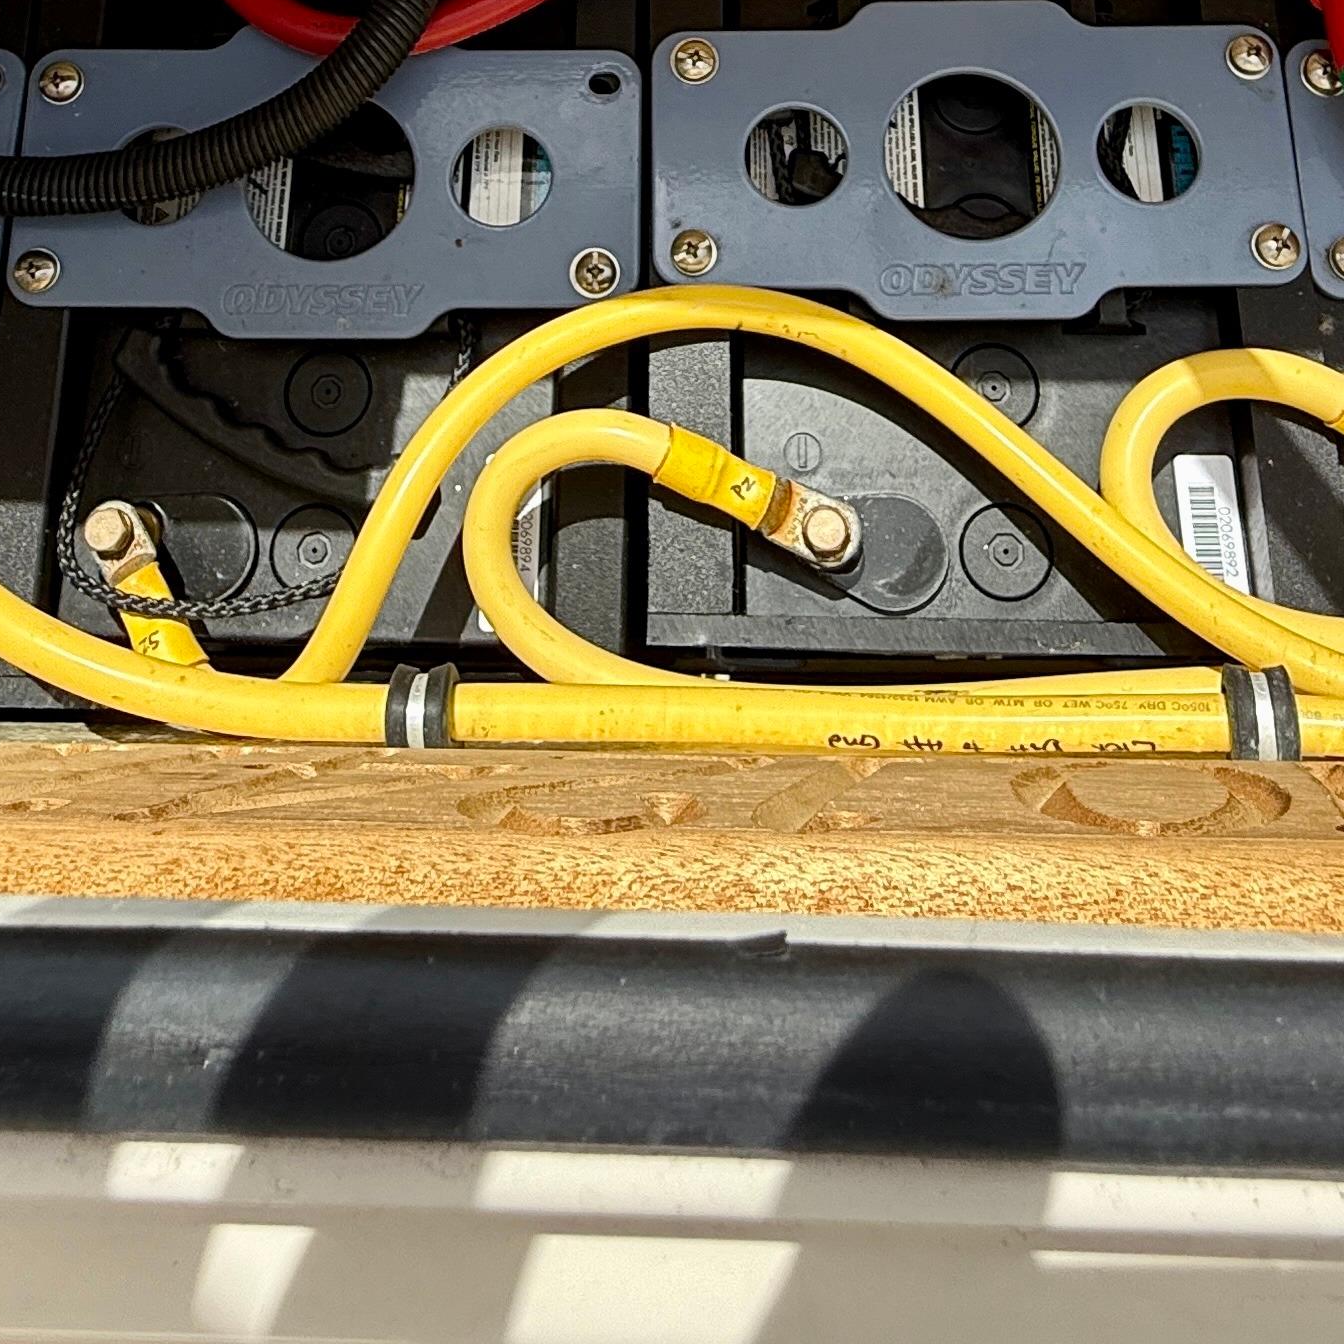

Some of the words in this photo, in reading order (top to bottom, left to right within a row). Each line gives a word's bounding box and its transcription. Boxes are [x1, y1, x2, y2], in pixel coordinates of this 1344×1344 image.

[879, 263, 1087, 298] ODYSSEY
[219, 281, 426, 318] ODYSSEY
[1217, 506, 1239, 577] 02069892
[1063, 698, 1091, 709] WET
